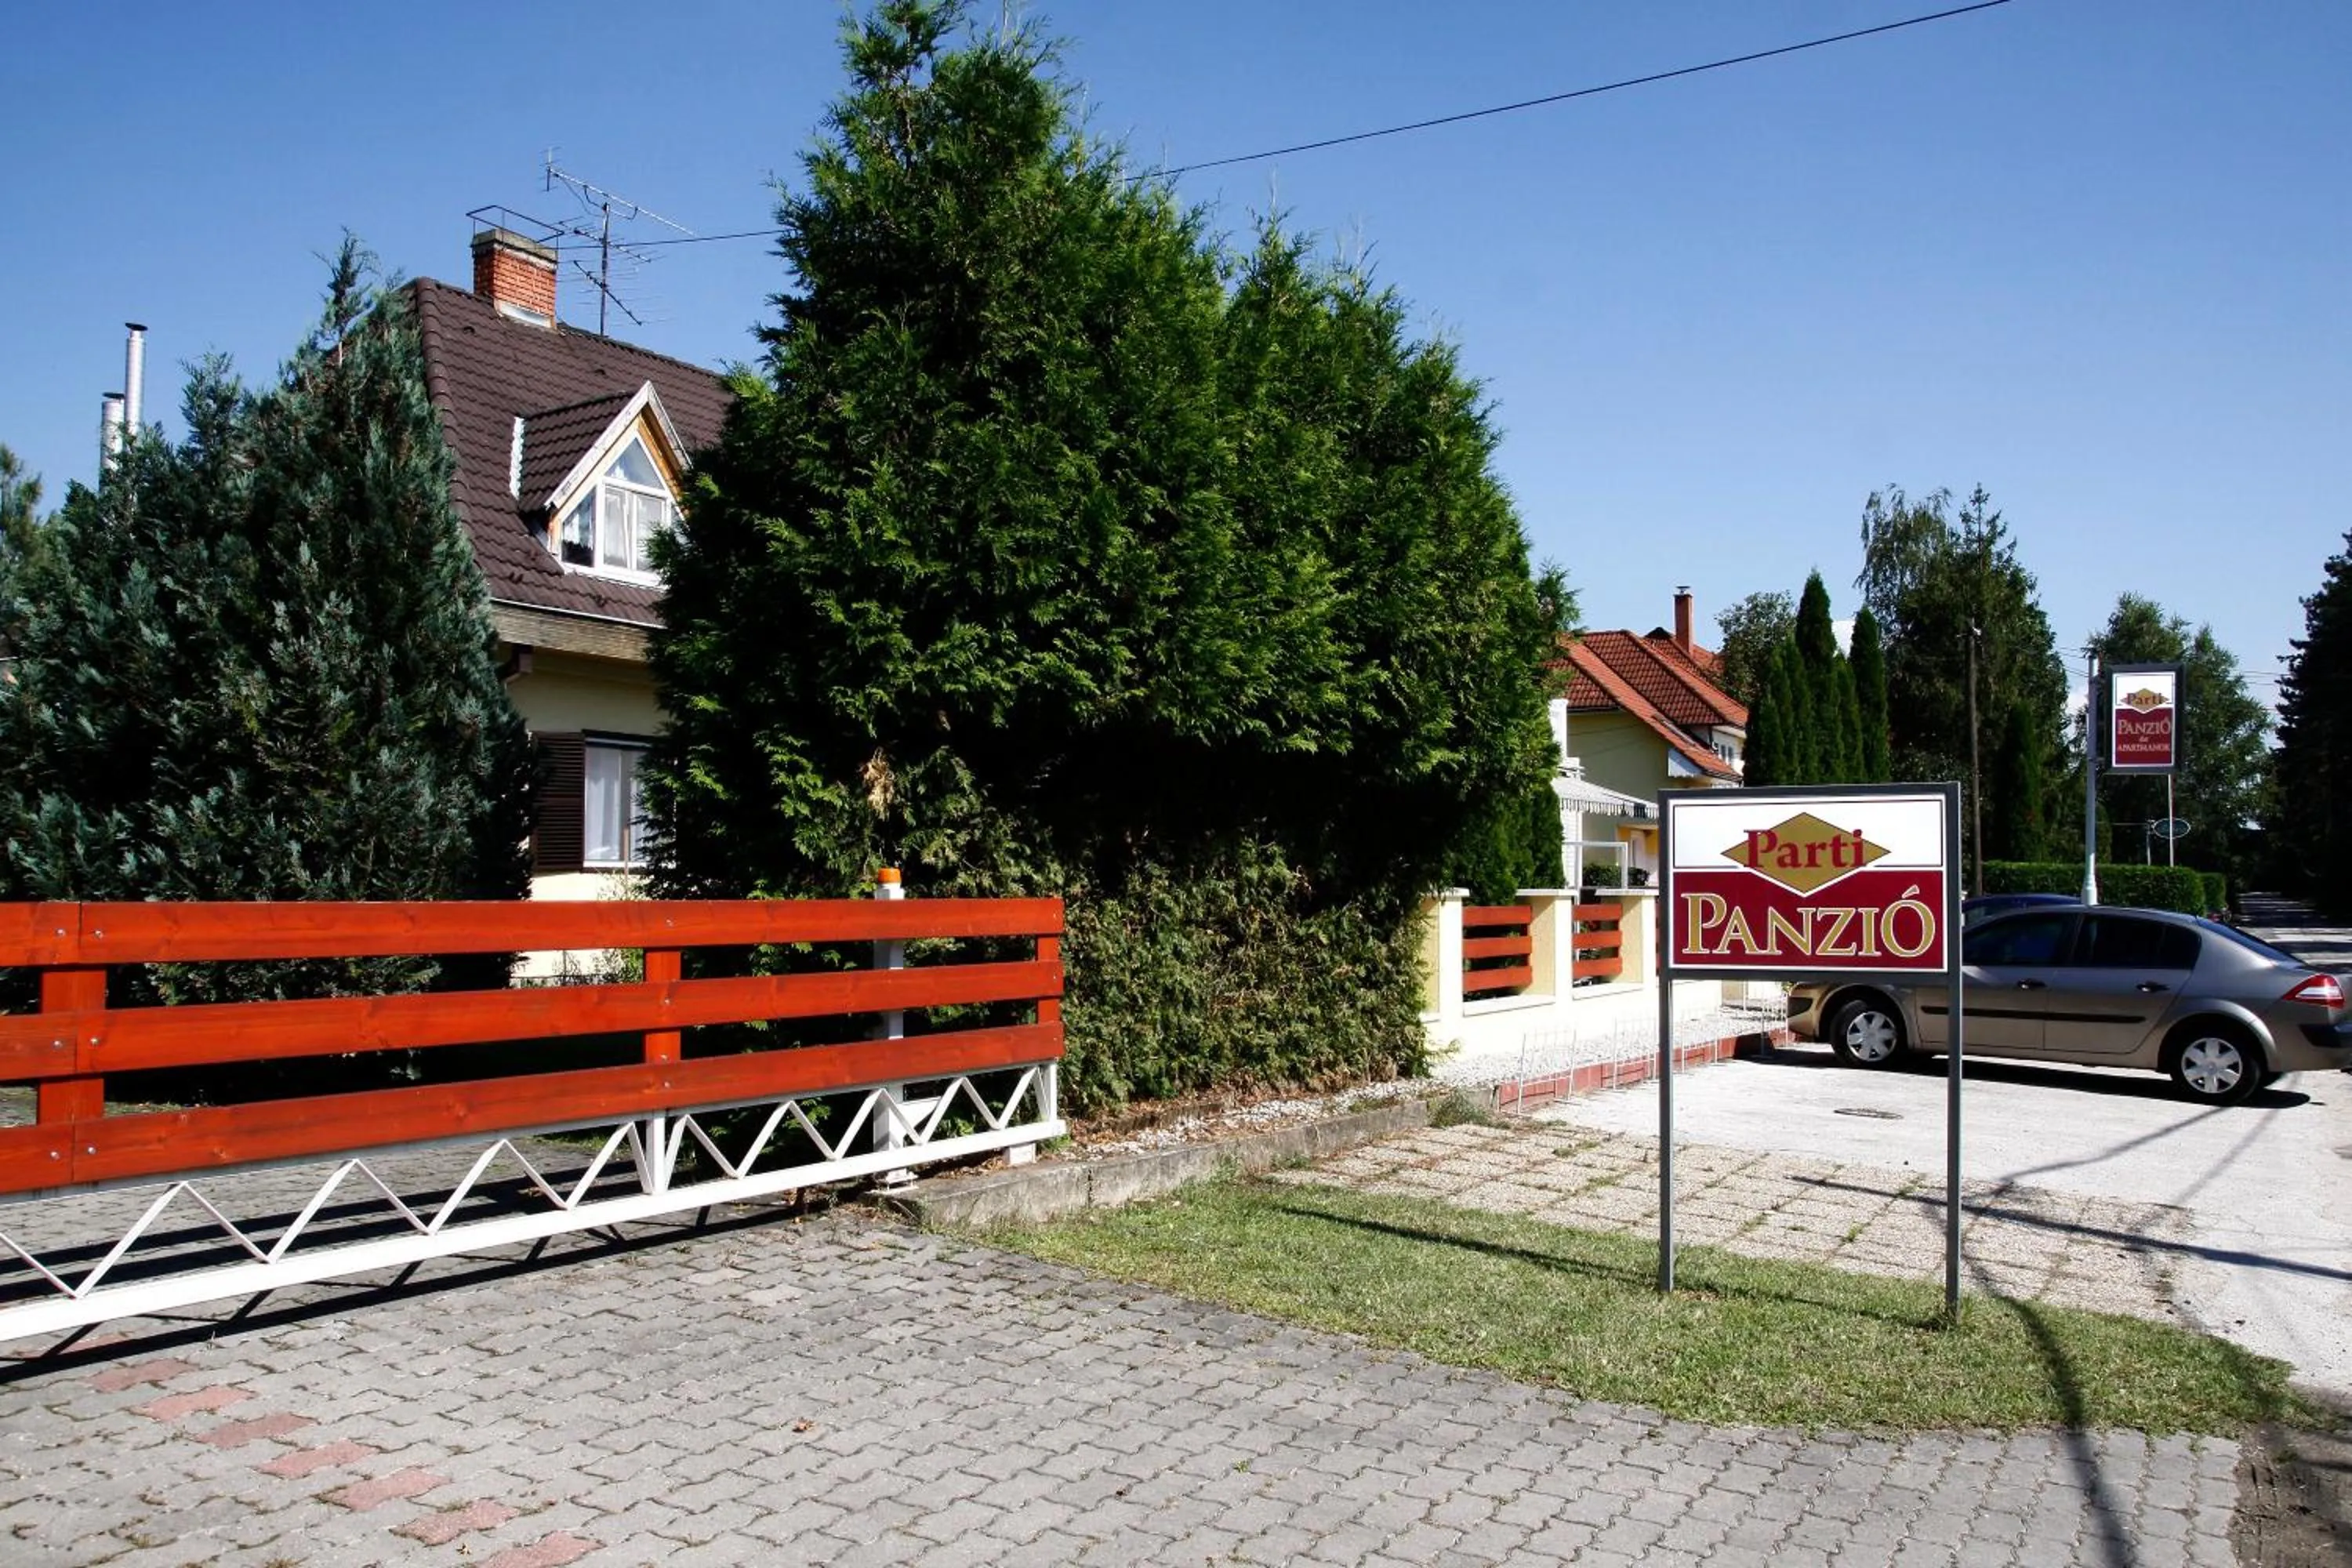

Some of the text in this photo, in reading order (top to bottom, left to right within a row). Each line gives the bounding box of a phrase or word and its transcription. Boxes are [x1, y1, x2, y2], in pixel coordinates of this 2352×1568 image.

[2127, 692, 2161, 705] Parti
[2118, 717, 2171, 735] PANZIÓ
[1744, 829, 1866, 868] Parti
[1681, 884, 1936, 957] PANZIÓ
